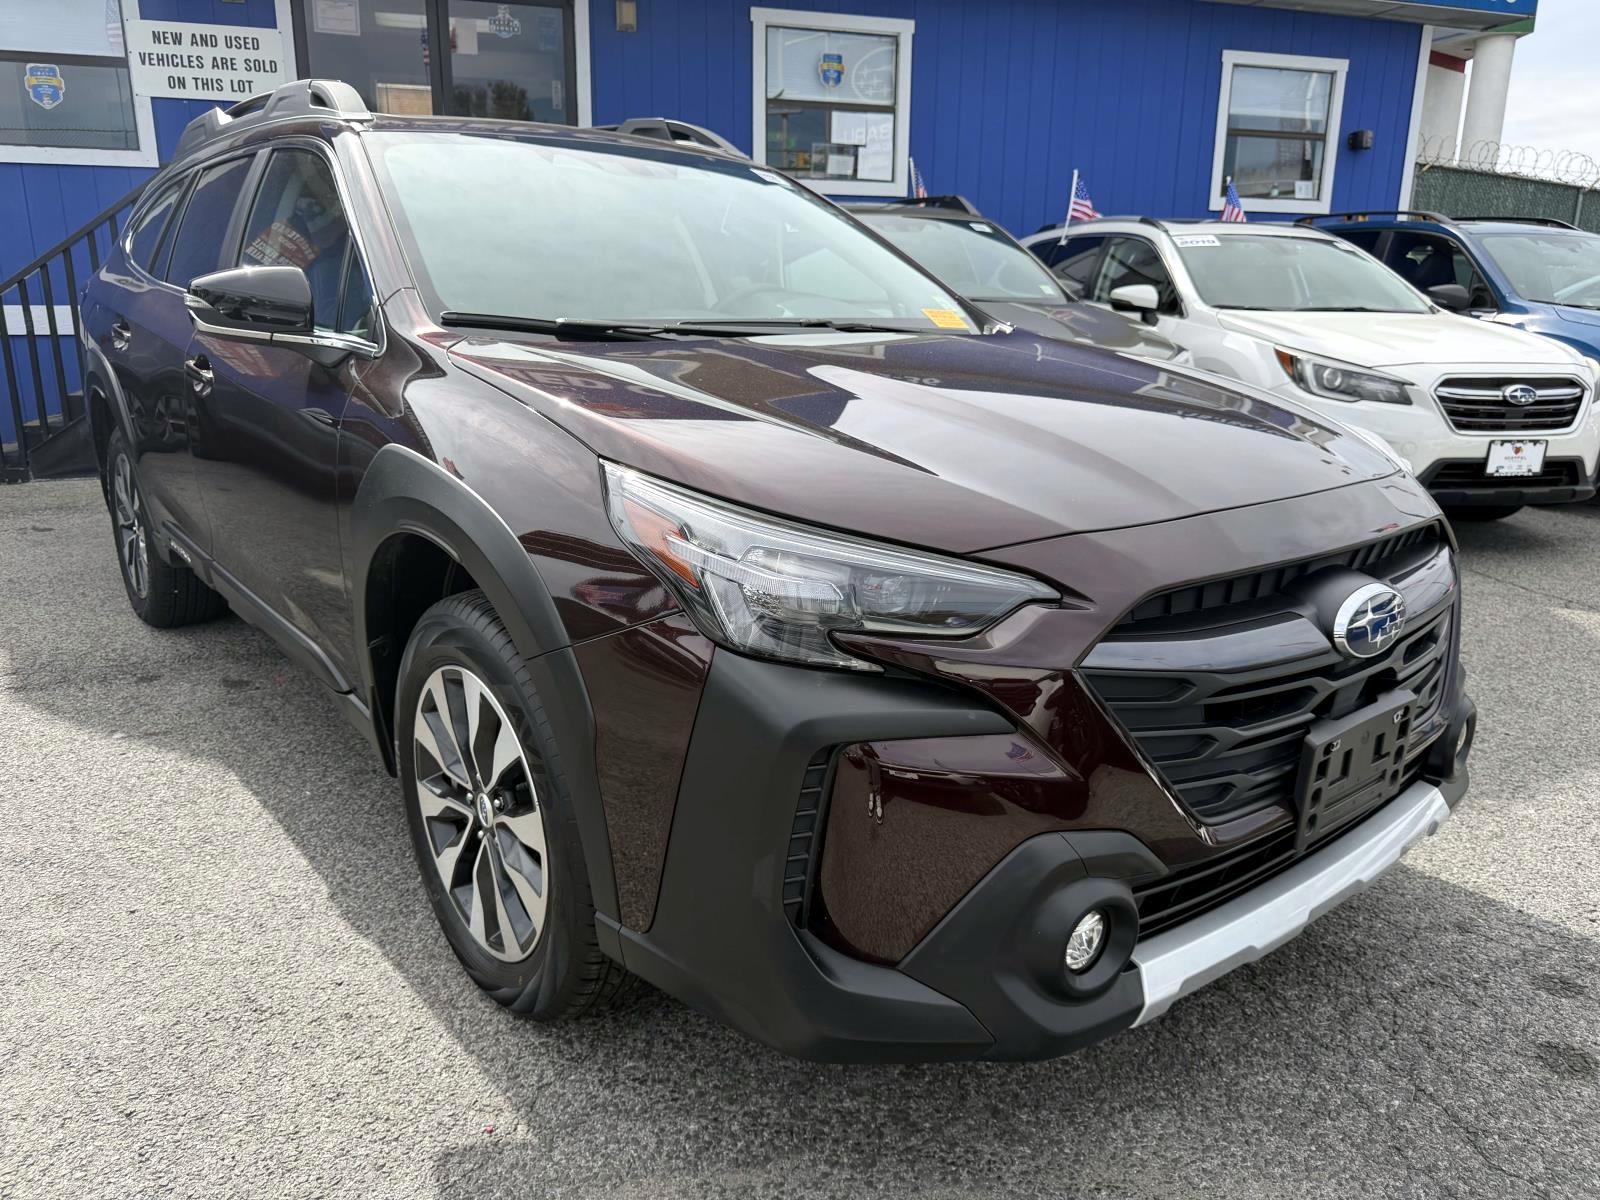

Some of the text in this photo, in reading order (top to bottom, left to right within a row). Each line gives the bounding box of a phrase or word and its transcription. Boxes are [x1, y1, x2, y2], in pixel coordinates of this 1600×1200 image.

[151, 30, 260, 51] NEW AND USED
[138, 51, 278, 73] VEHICLES ARE SOLD
[167, 75, 254, 93] ON THIS LOT
